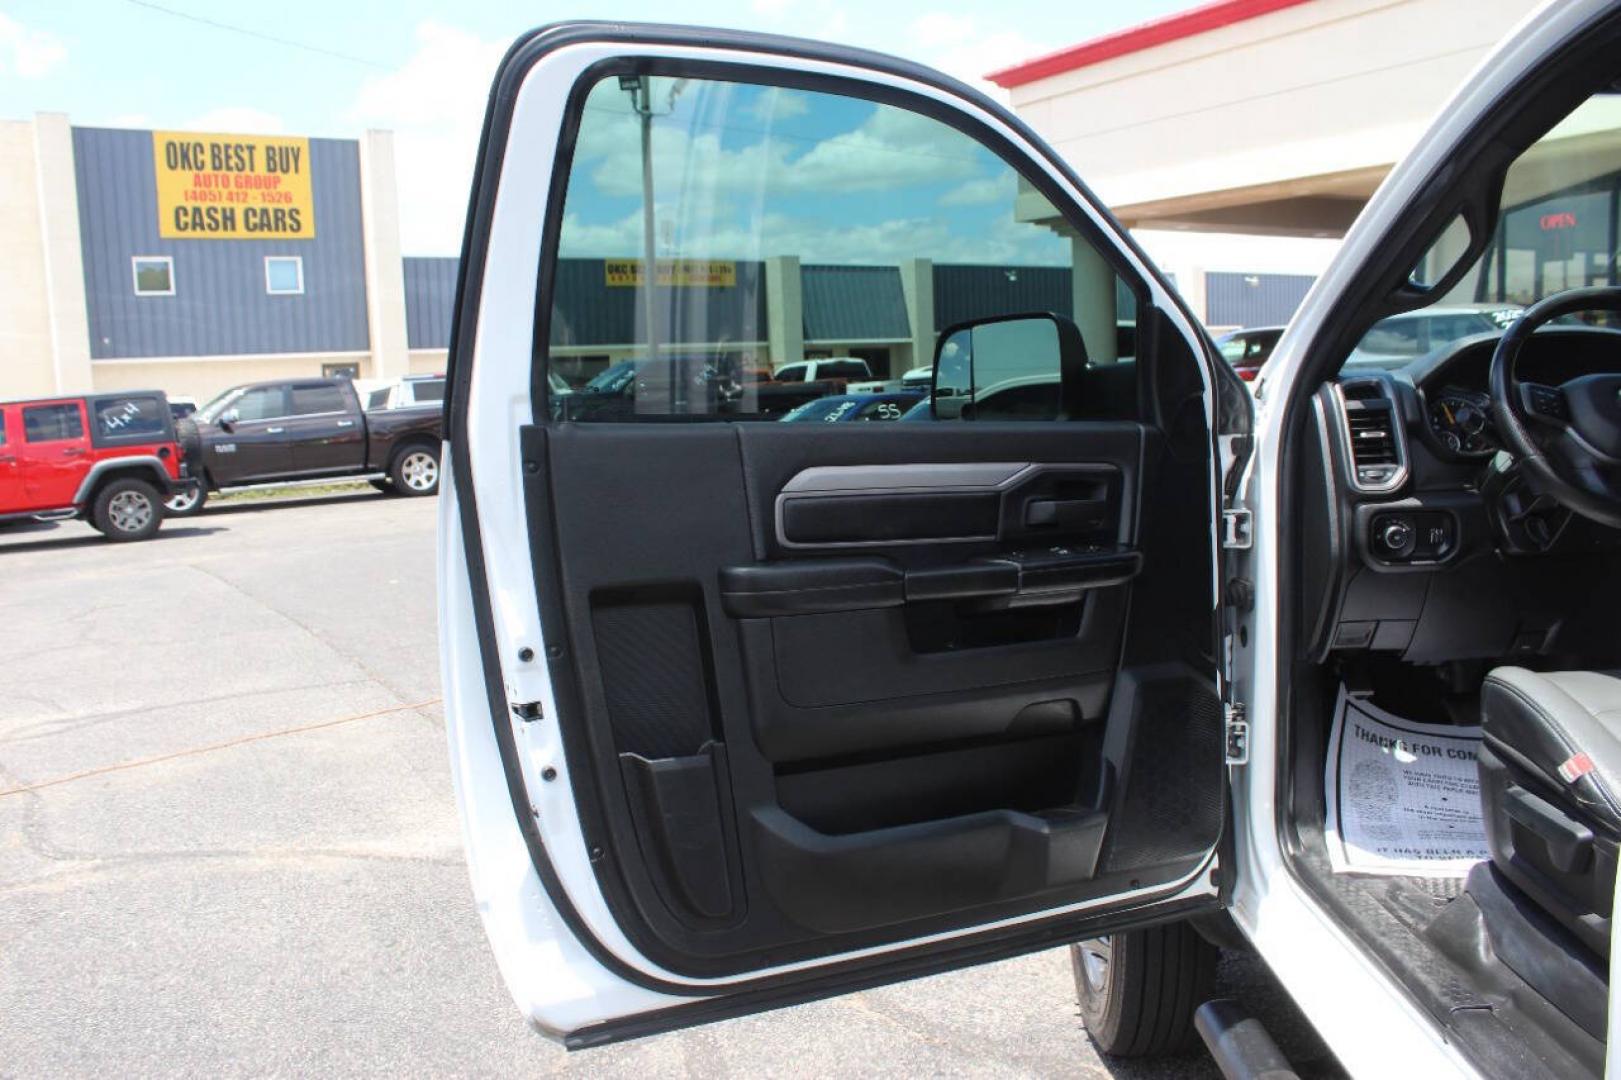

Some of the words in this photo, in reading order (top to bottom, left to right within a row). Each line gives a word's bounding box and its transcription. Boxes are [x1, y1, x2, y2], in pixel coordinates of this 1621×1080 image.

[166, 141, 205, 171] OKC
[210, 143, 256, 172] BEST
[266, 145, 301, 174] BUY
[193, 174, 230, 189] AUTO
[234, 175, 281, 190] GROUP
[226, 191, 248, 203] 412
[174, 205, 236, 232] CASH
[244, 207, 302, 233] CARS
[1539, 212, 1577, 231] OPEN
[1412, 742, 1443, 758] FOR
